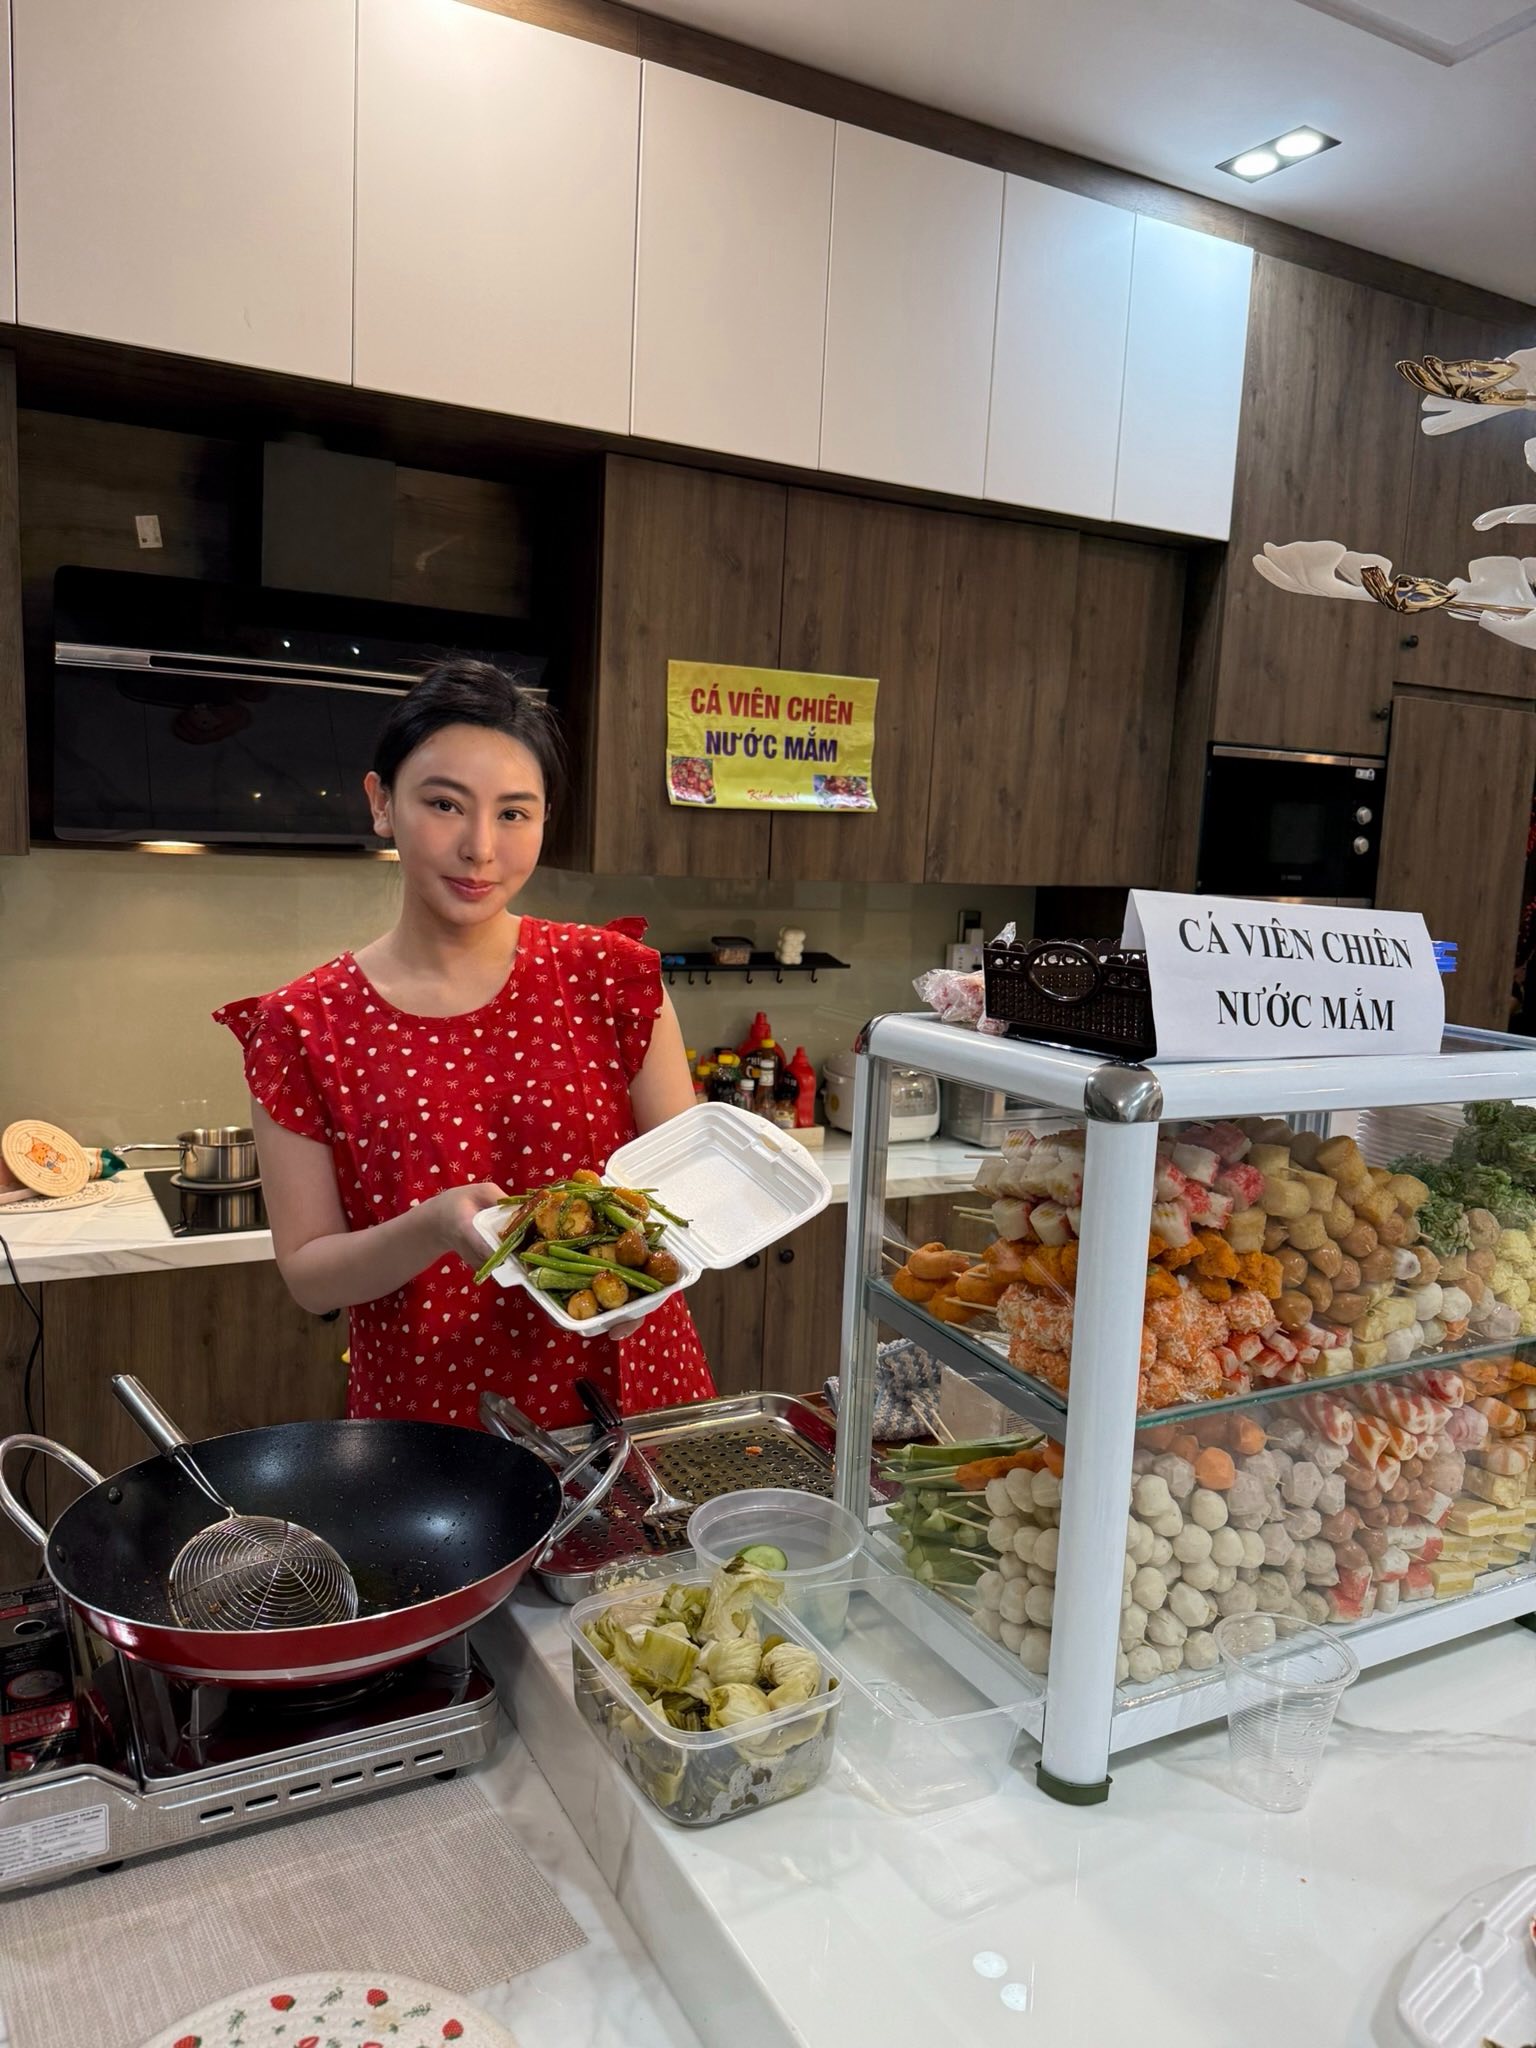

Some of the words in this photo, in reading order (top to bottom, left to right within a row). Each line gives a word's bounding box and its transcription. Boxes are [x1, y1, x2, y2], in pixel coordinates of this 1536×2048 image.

[690, 683, 722, 715] CÁ
[728, 687, 781, 720] VIÊN
[786, 693, 854, 726] CHIÊN
[705, 727, 777, 760] NƯỚC
[784, 725, 838, 763] MẮM
[1178, 911, 1231, 955] CÁ
[1232, 917, 1315, 961] VIÊN
[1321, 927, 1414, 969] CHIÊN
[1216, 982, 1312, 1029] NƯỚC
[1321, 987, 1395, 1032] MẮM
